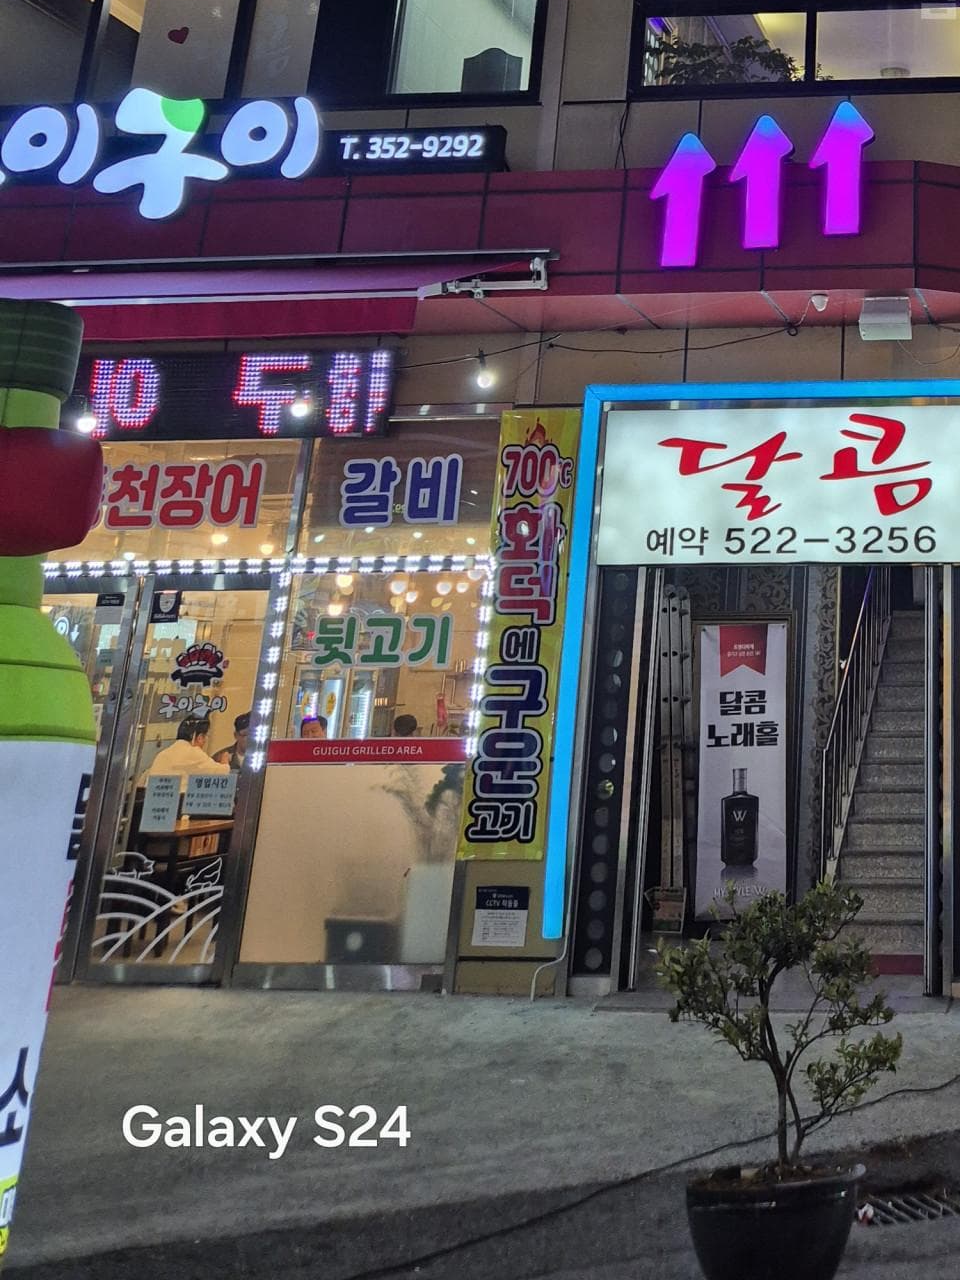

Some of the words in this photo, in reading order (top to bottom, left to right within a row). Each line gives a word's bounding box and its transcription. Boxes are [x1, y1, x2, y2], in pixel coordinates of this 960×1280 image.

[0, 88, 319, 219] 이구이
[366, 132, 484, 159] 352-9292
[658, 413, 932, 520] 달콤
[102, 459, 265, 529] 천장어
[340, 456, 460, 525] 갈비
[646, 526, 709, 556] 예약
[724, 526, 937, 554] 522-3256
[313, 614, 452, 666] 뒷고기
[719, 690, 767, 716] 달콤
[313, 746, 350, 756] GUIGUI
[352, 746, 394, 755] GRILLED
[398, 746, 423, 755] AREA
[706, 721, 779, 748] 노래홀
